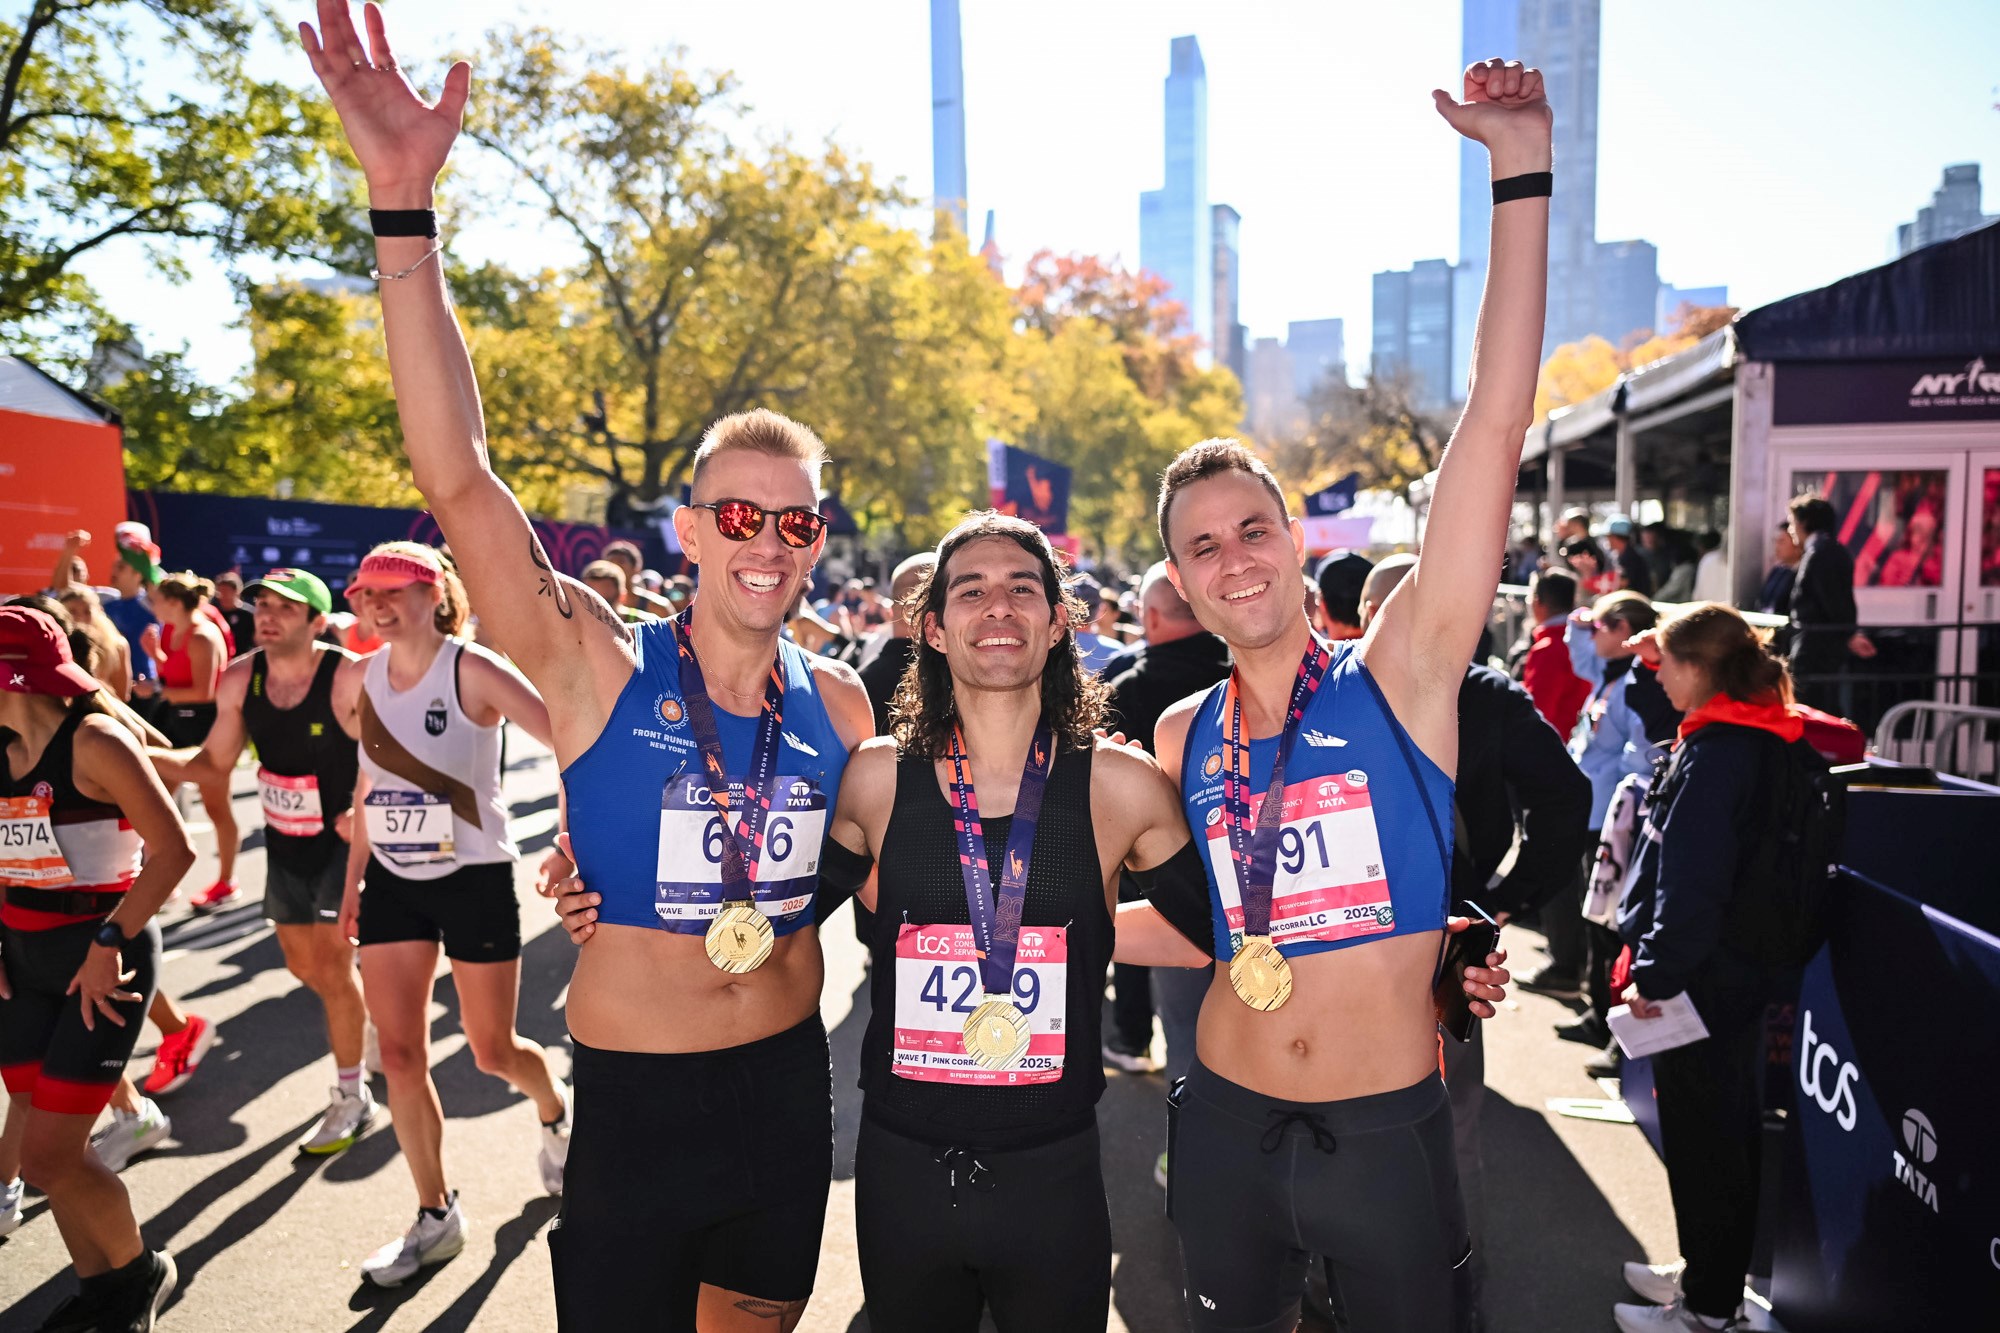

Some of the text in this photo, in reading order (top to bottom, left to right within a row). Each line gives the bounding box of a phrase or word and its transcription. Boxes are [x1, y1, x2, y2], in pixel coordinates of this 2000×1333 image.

[766, 698, 777, 743] MANHATTAN
[633, 728, 662, 740] FRONT
[1232, 725, 1240, 754] ISLAND
[649, 741, 687, 755] NEW YORK
[759, 751, 769, 778] BRONX
[756, 781, 764, 797] THE
[957, 775, 968, 814] BROOKLYN
[1190, 789, 1205, 804] FRONT
[1232, 763, 1241, 806] BROOKLYN
[786, 798, 812, 807] TATA
[1197, 793, 1223, 805] NEW YORK
[1317, 797, 1347, 809] TATA
[385, 809, 427, 833] 577
[748, 807, 759, 841] QUEENS
[1234, 816, 1244, 850] QUEENS
[0, 822, 50, 846] 2574
[702, 815, 794, 864] 66
[964, 822, 975, 853] QUEENS
[1276, 820, 1330, 875] 91
[971, 863, 980, 880] THE
[1241, 859, 1249, 876] THE
[781, 898, 804, 912] 2025
[974, 883, 984, 911] BRONX
[658, 907, 683, 915] WAVE
[698, 907, 718, 916] BLUE
[1279, 920, 1309, 931] CORRAL
[1308, 913, 1327, 927] LC
[1343, 905, 1378, 920] 2025
[916, 931, 950, 955] tcs
[1018, 949, 1046, 958] TATA
[920, 965, 1041, 1015] 429
[897, 1053, 919, 1062] WAVE
[921, 1053, 927, 1064] 1
[932, 1057, 950, 1065] PINK
[1020, 1057, 1052, 1069] 2025
[1800, 1009, 1859, 1132] tcs
[1009, 1073, 1017, 1082] B
[1893, 1150, 1939, 1214] TATA
